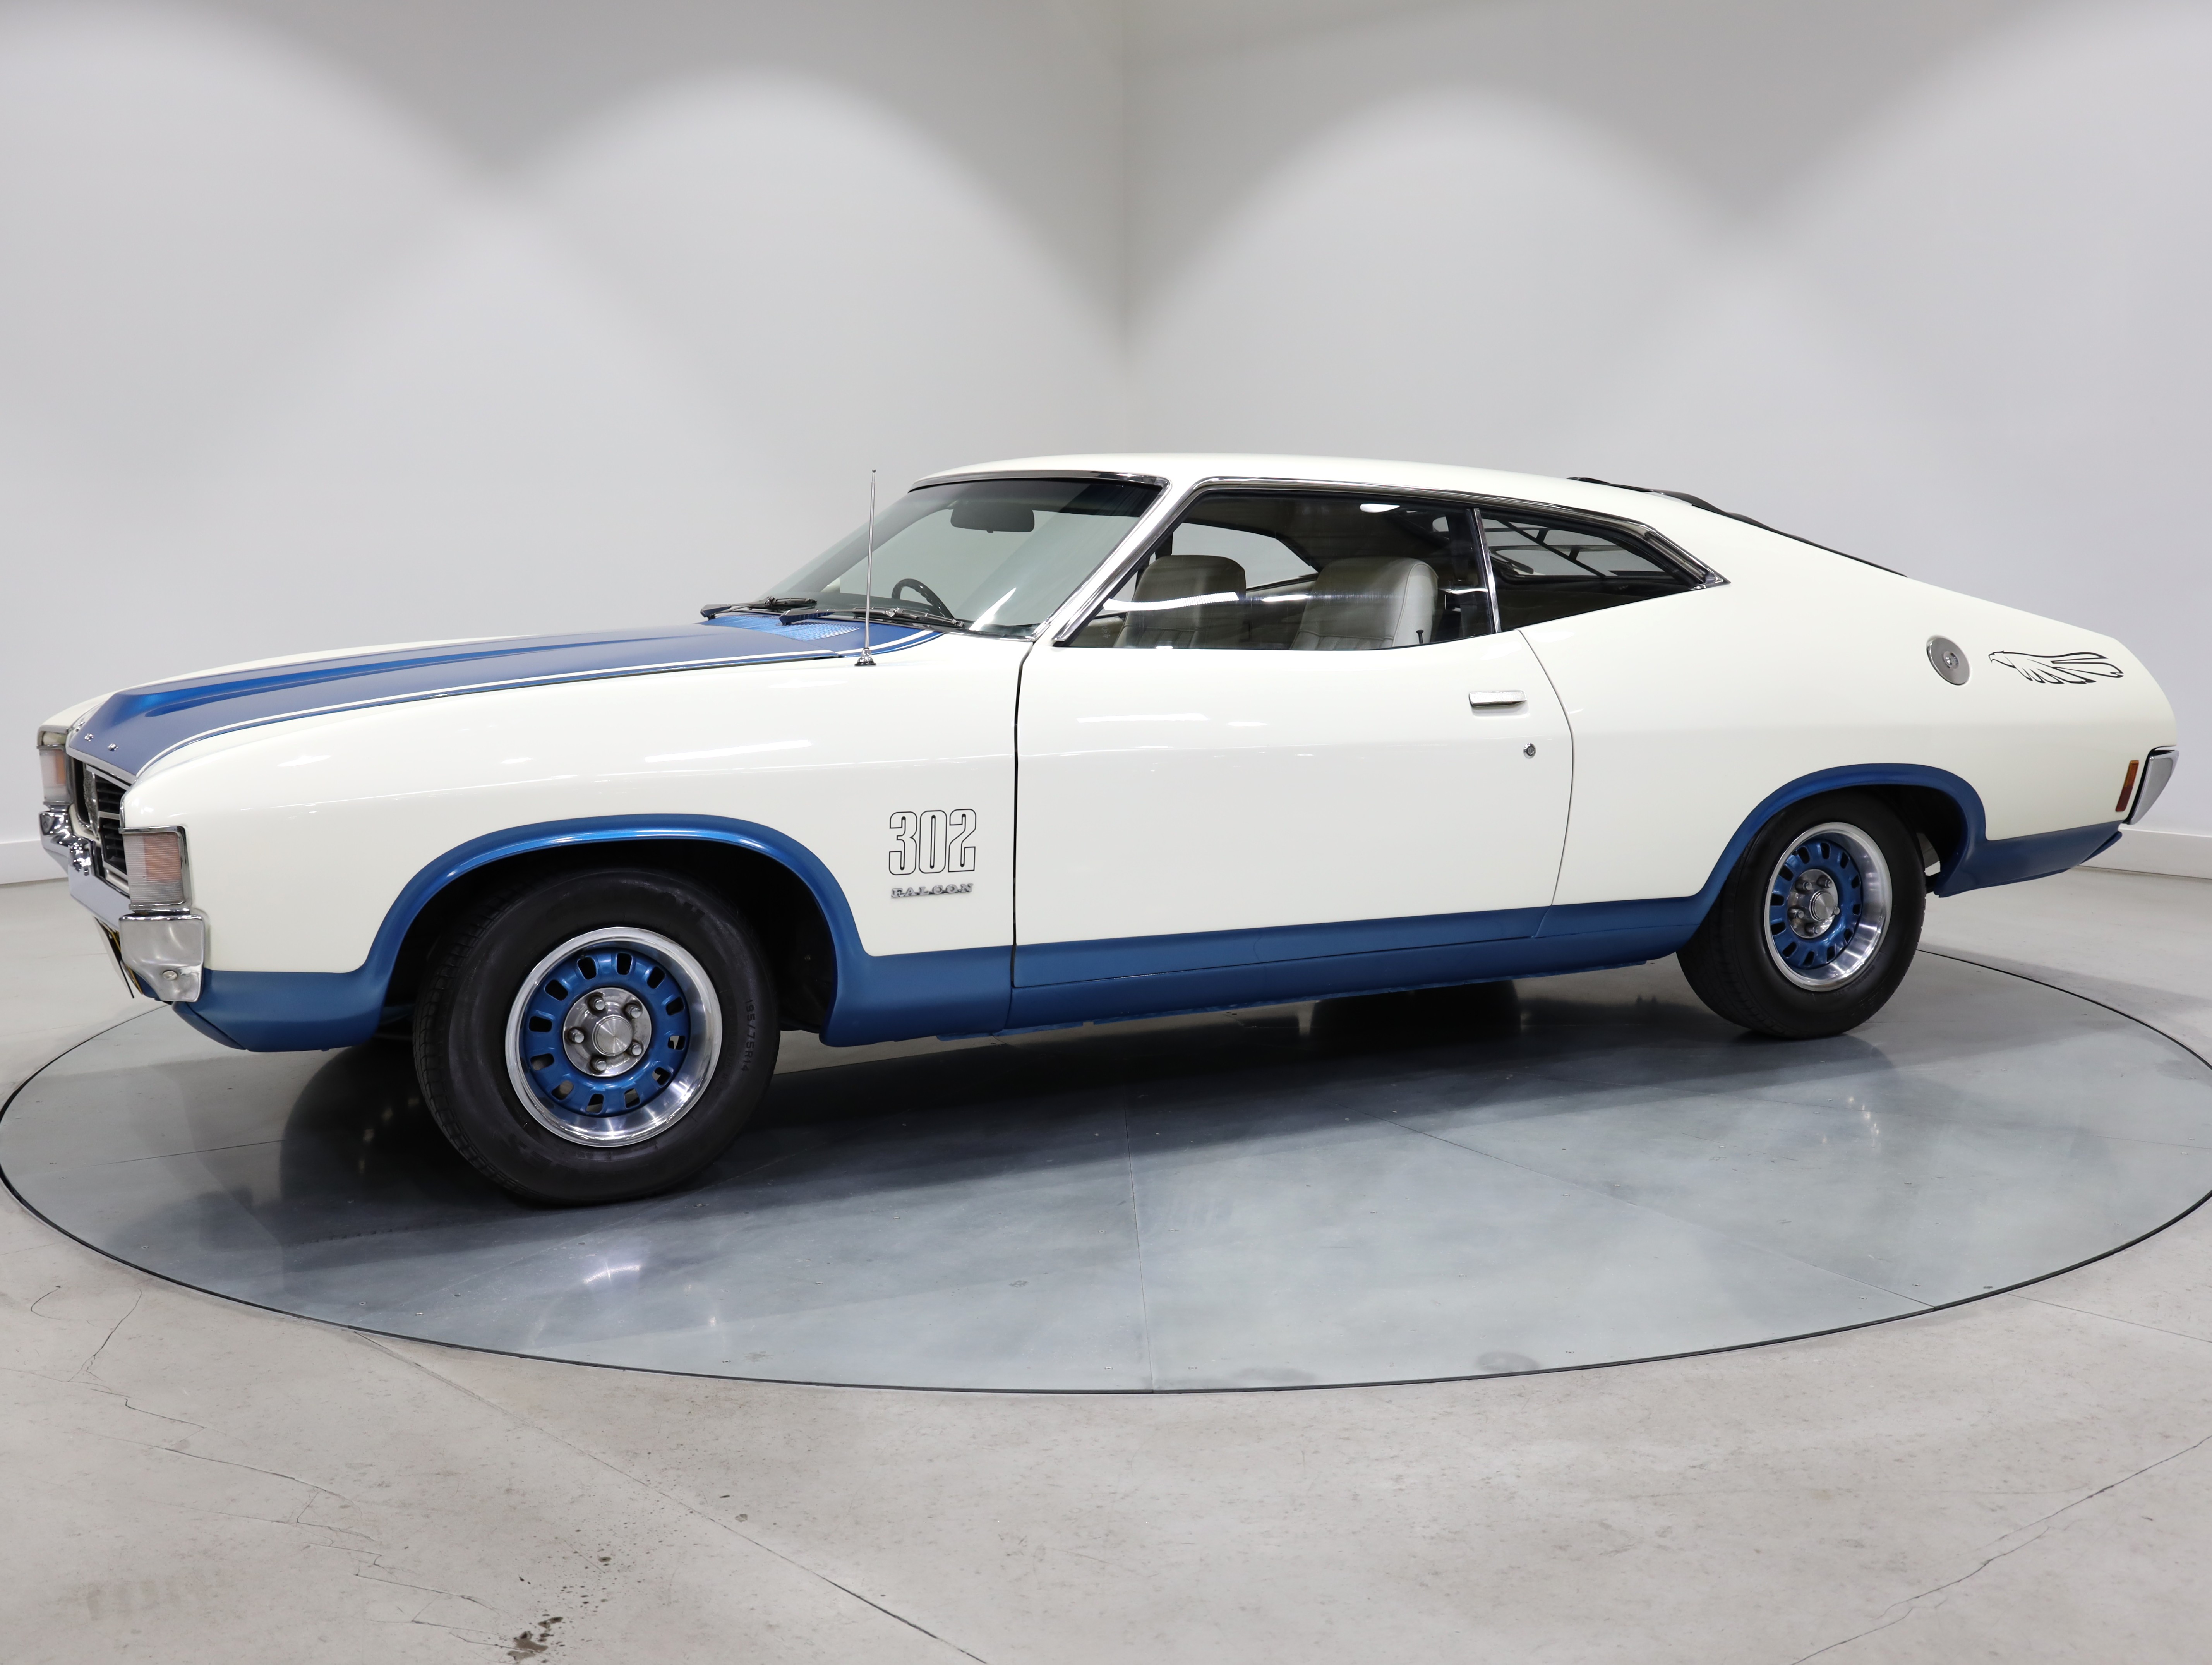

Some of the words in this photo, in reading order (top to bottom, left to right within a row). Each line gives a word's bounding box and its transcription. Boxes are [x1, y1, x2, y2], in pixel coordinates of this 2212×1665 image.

[889, 809, 976, 875] 302
[891, 883, 973, 897] FALCON
[741, 999, 756, 1072] 195/75R14
